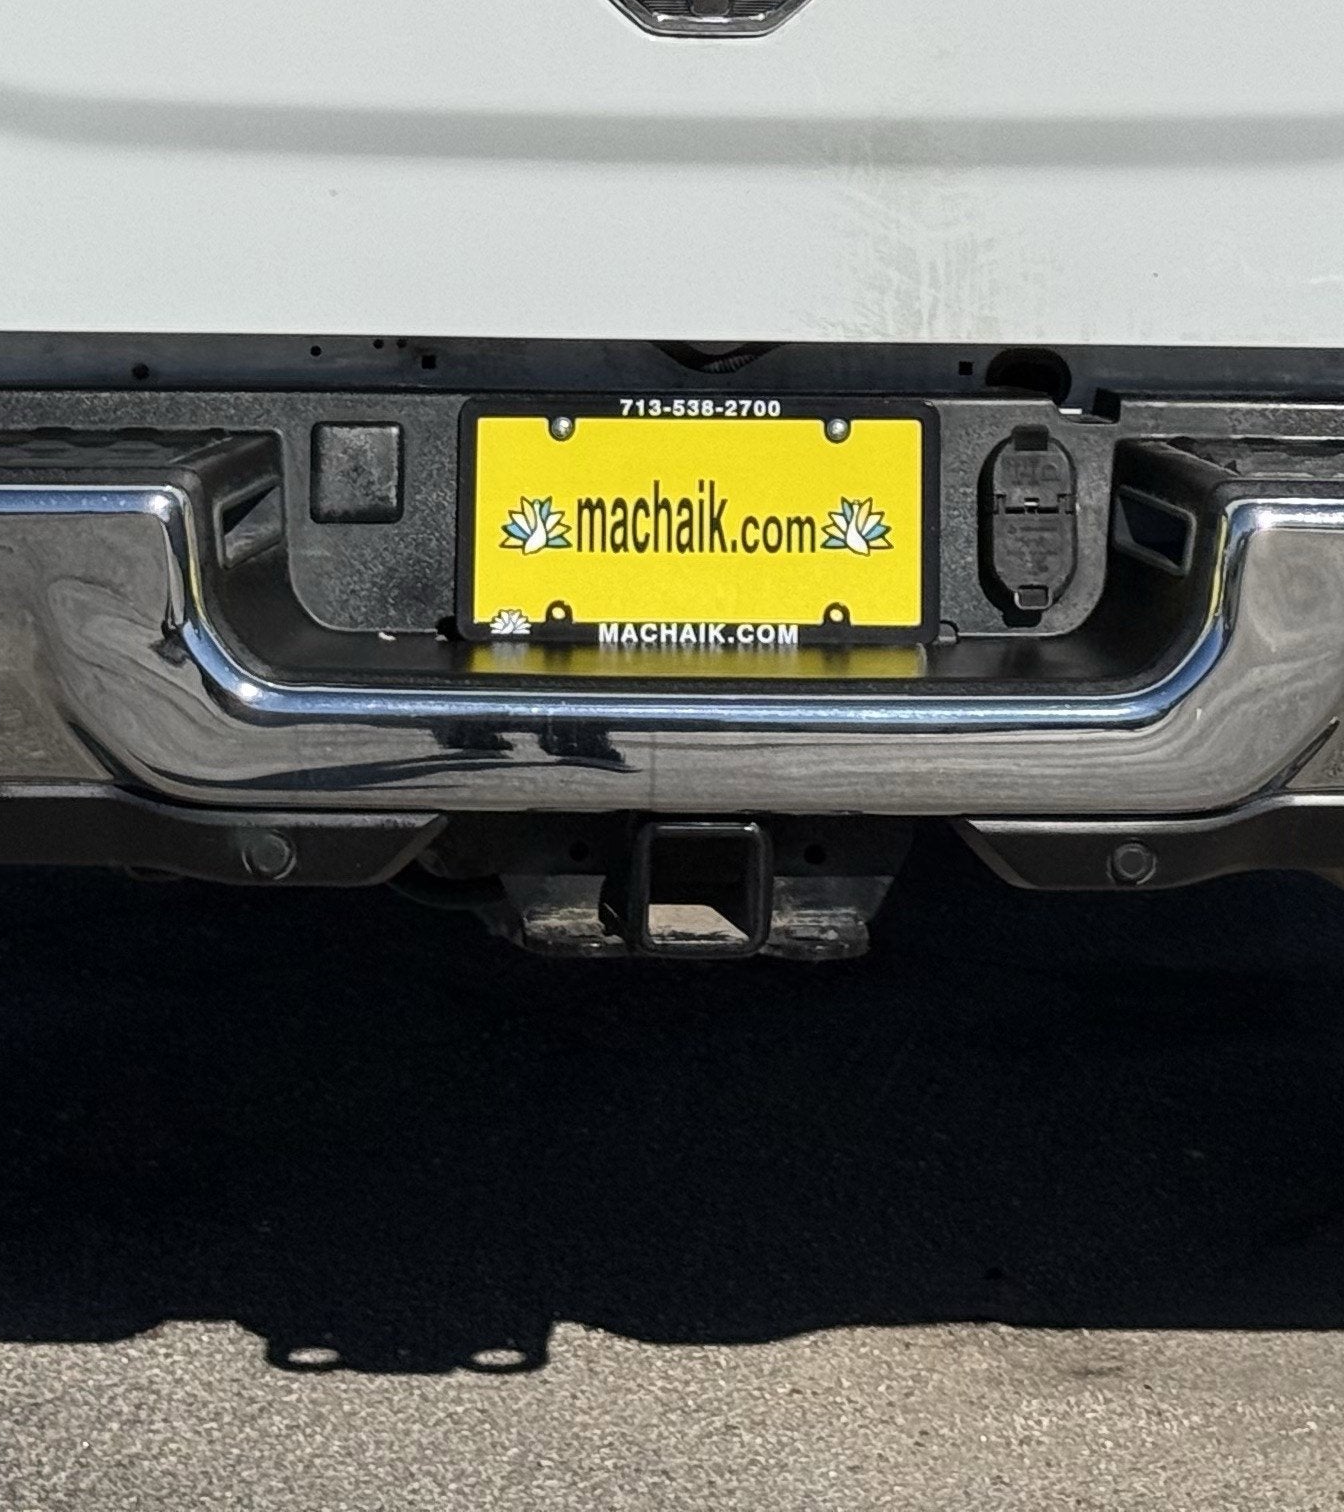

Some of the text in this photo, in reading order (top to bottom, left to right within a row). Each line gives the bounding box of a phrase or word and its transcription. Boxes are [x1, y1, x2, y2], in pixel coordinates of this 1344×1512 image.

[620, 399, 782, 418] 713-538-2700
[576, 480, 817, 554] machaik.com
[598, 623, 799, 645] MACHAIK.COM
